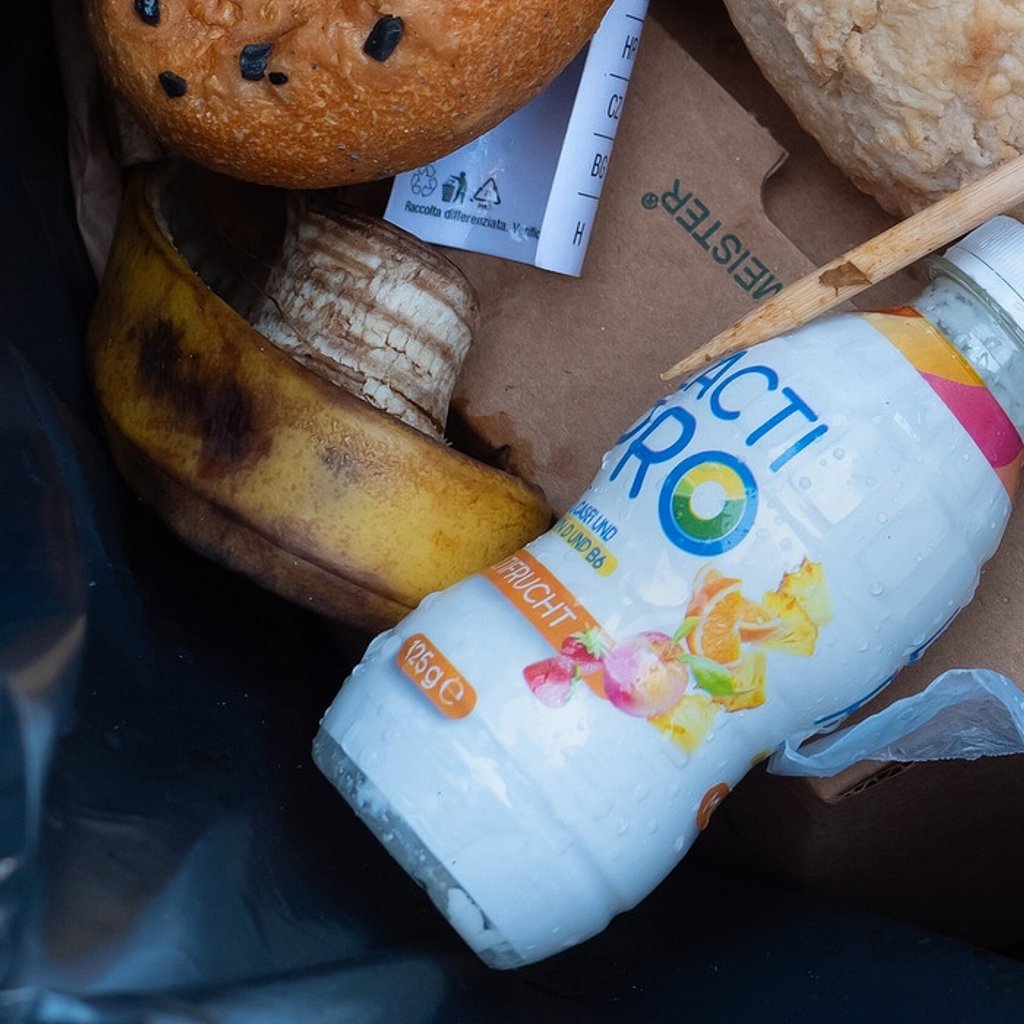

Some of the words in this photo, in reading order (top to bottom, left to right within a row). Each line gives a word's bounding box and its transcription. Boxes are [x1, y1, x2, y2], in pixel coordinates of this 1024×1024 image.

[404, 200, 442, 218] Raccolta
[572, 221, 585, 247] H
[591, 515, 619, 542] UND
[584, 546, 608, 570] B6
[404, 639, 445, 690] 125g
